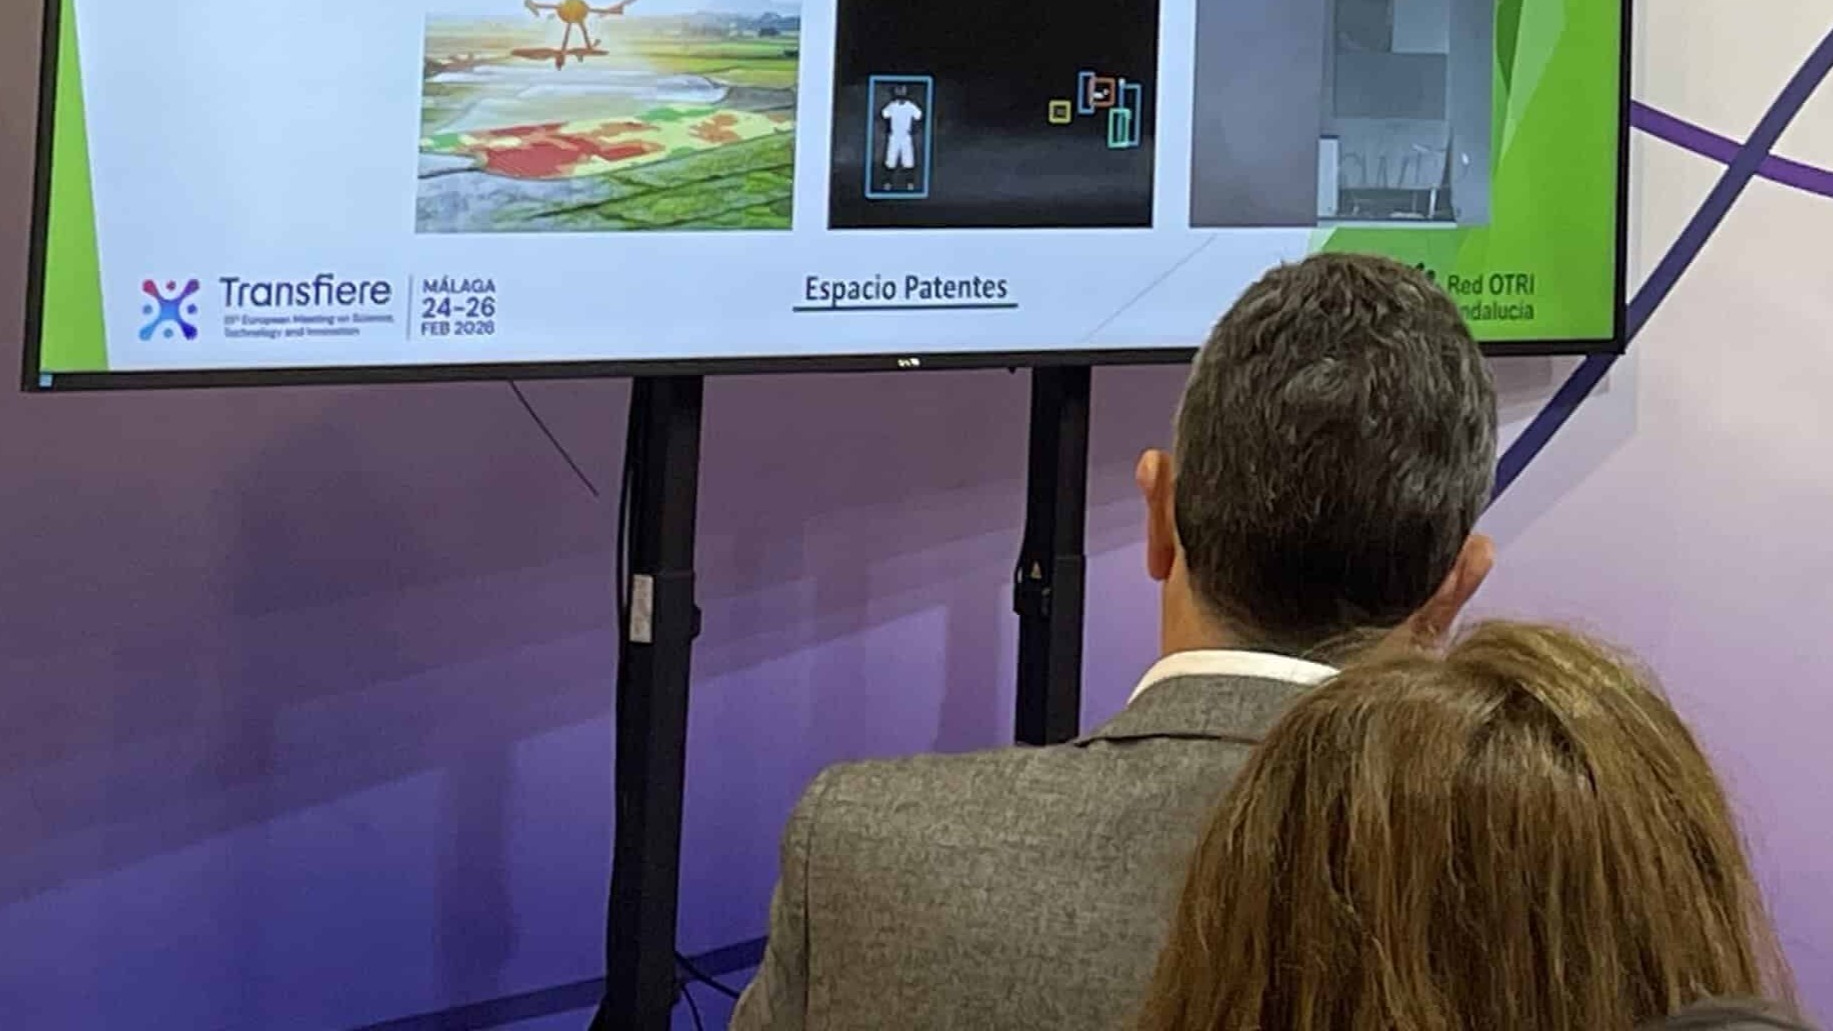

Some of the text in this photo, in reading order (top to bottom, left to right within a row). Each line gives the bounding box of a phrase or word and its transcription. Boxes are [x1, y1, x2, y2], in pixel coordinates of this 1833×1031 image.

[219, 273, 392, 307] Transfiere
[422, 275, 496, 294] MÁLAGA
[806, 274, 1008, 307] Espacio Patentes
[1448, 273, 1535, 296] Red OTRI
[421, 295, 496, 318] 24-26
[1460, 300, 1535, 320] ndalucía
[421, 319, 495, 336] FEB 2026
